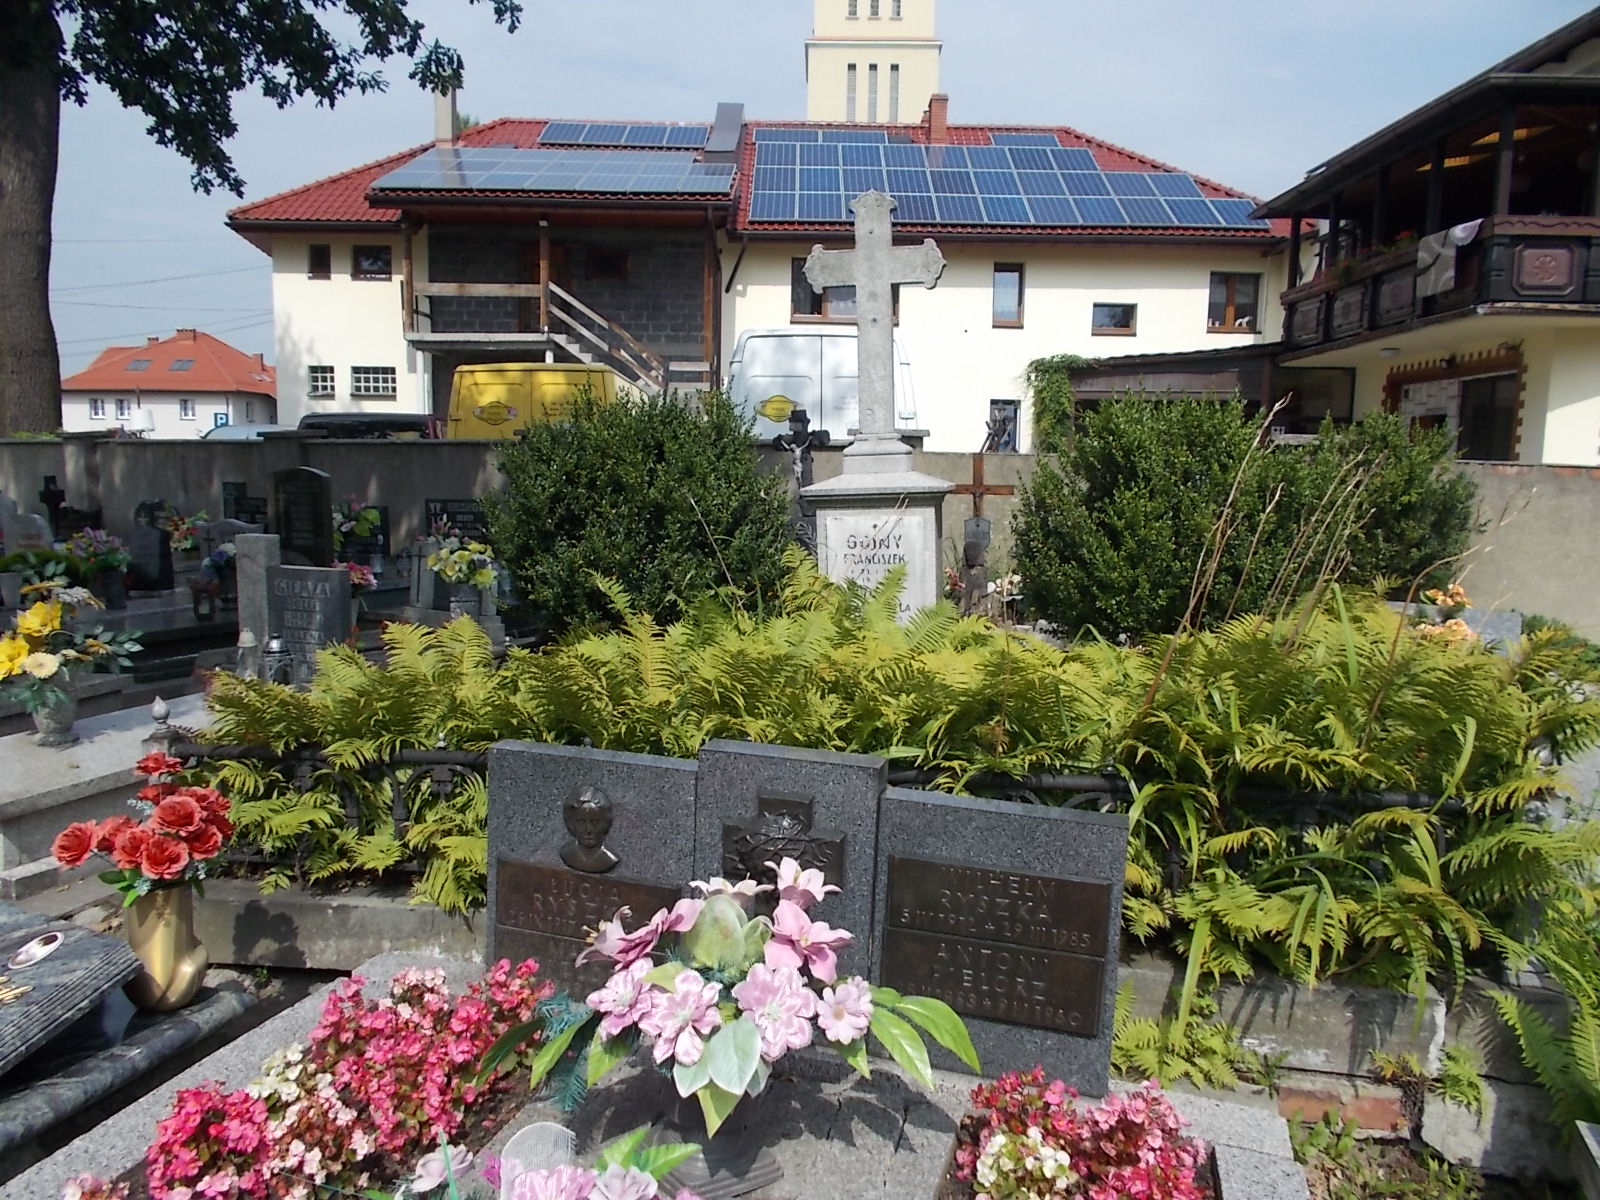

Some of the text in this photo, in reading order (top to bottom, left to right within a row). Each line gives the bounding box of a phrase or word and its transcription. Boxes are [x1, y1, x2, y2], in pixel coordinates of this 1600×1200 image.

[216, 413, 227, 427] P
[940, 866, 1057, 899] WILHELM
[939, 889, 1053, 923] RYSZKA
[1051, 928, 1092, 949] 1985
[936, 942, 1049, 973] ANTONI
